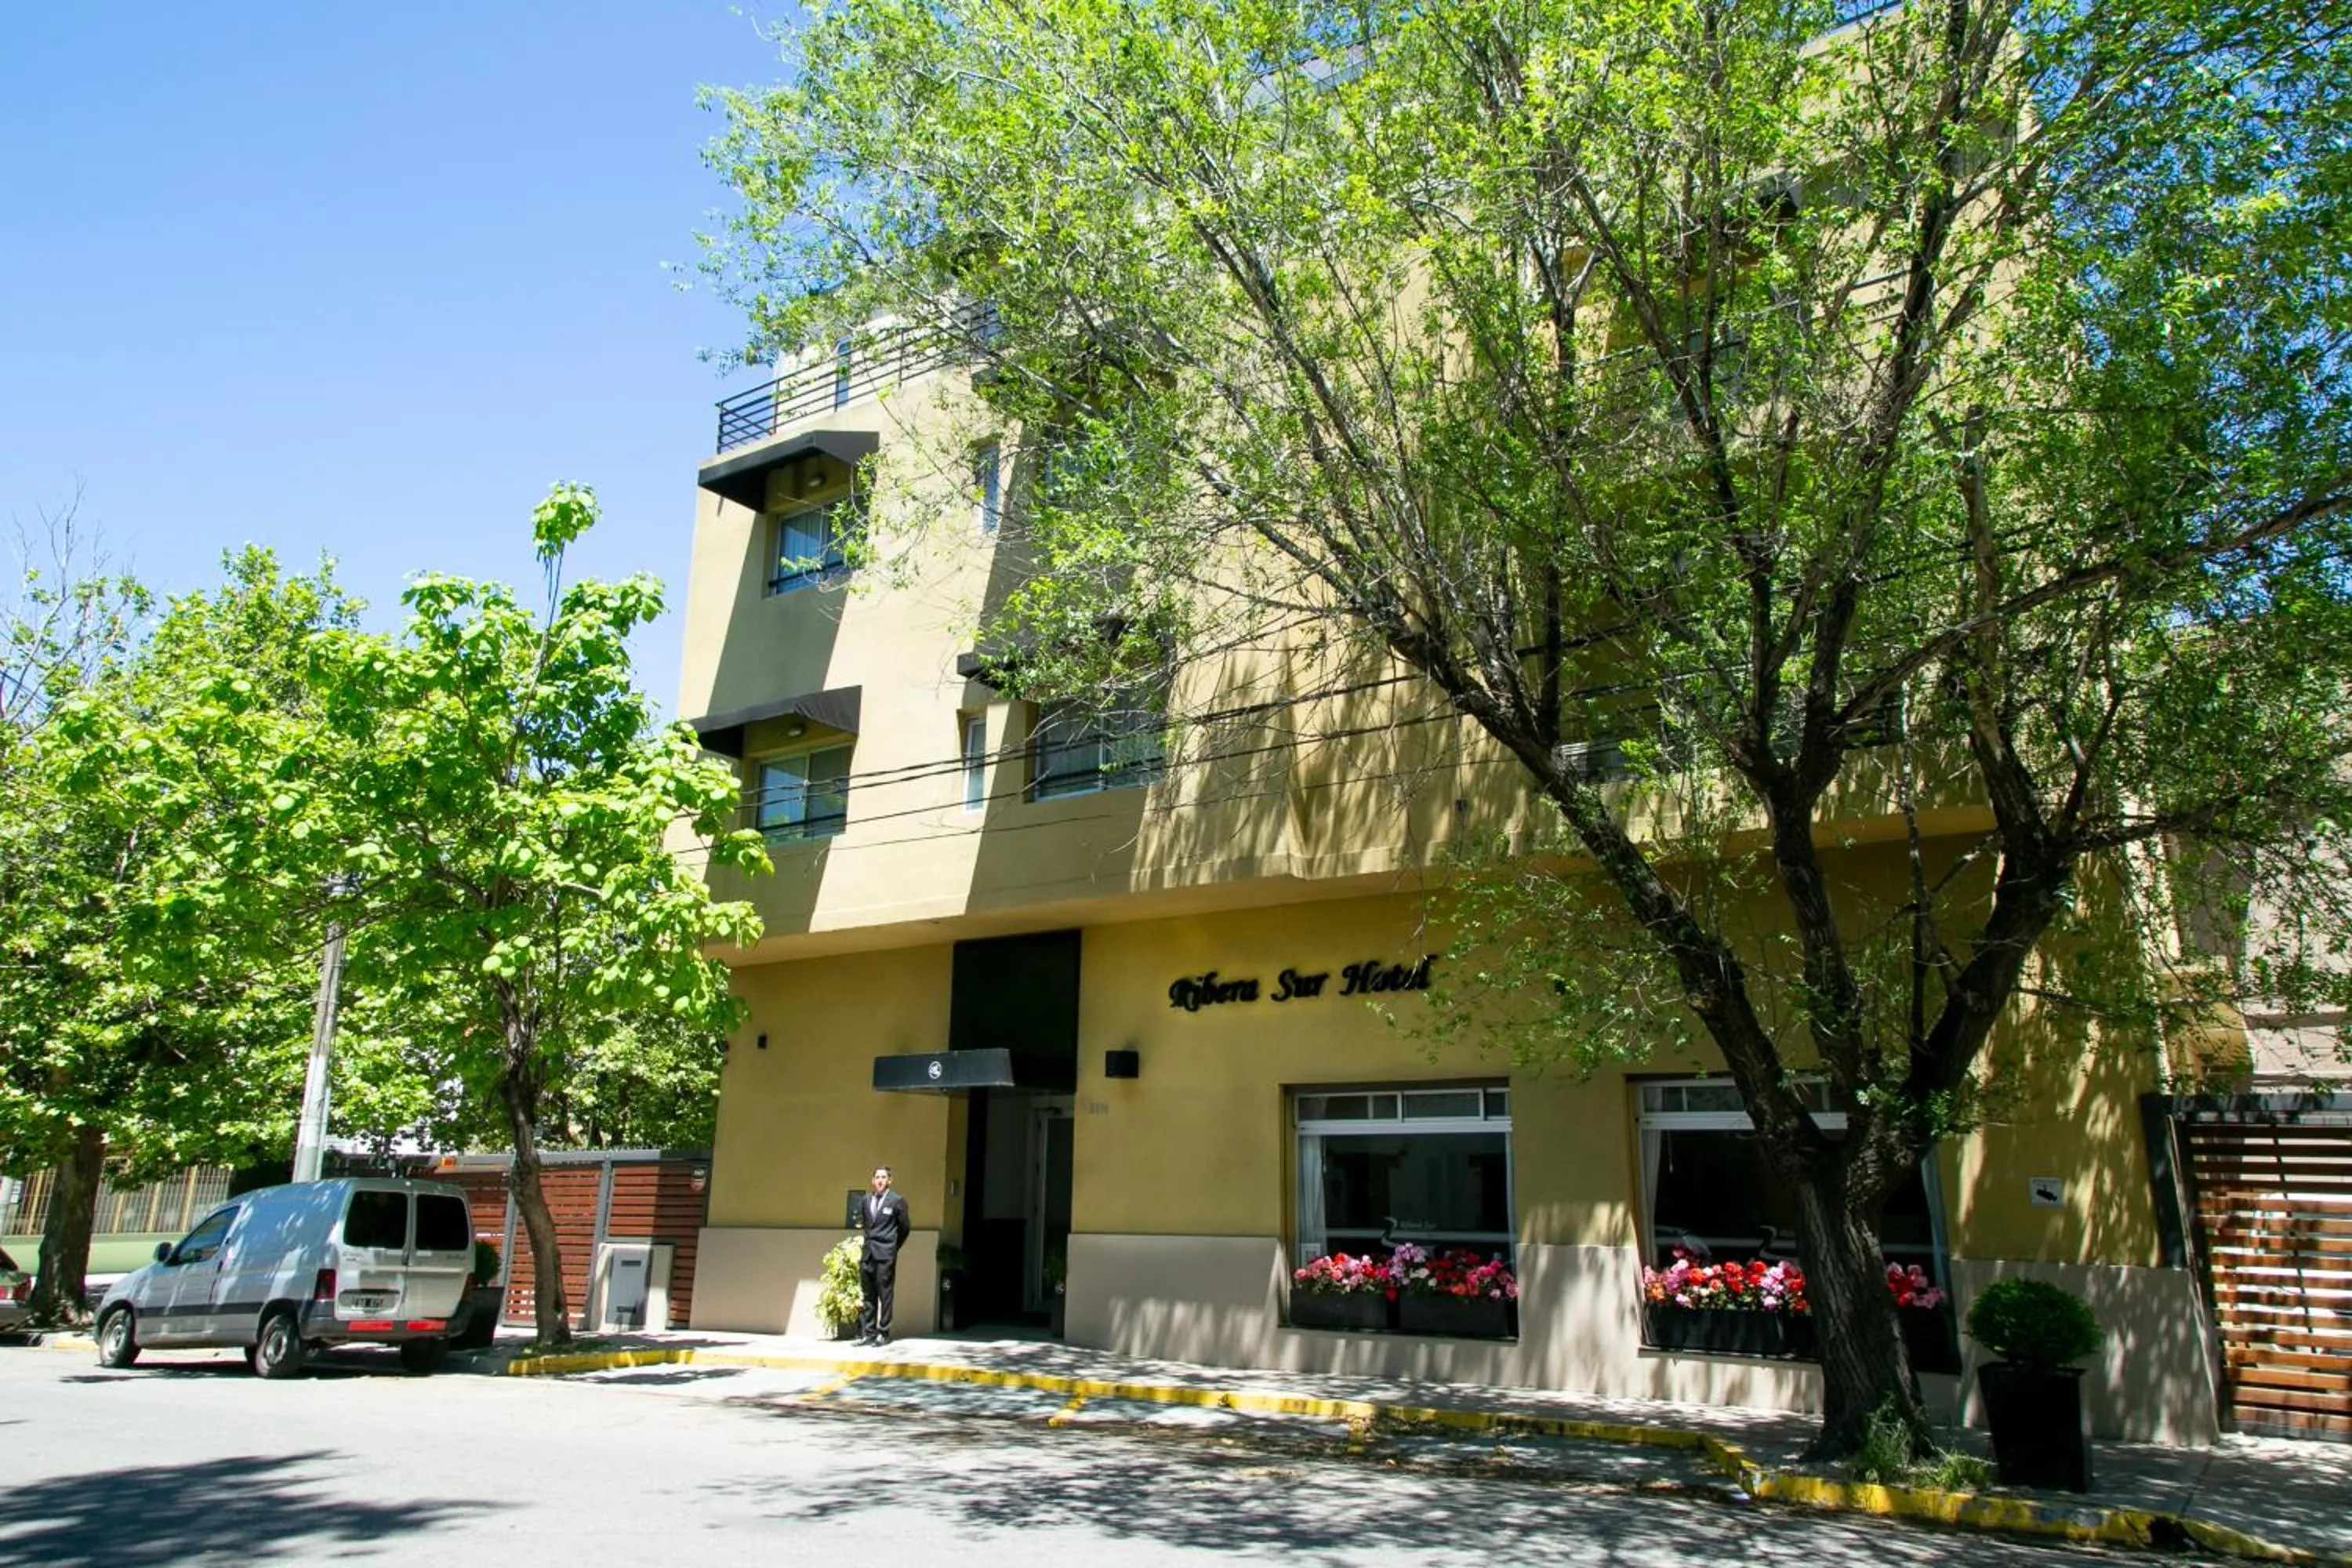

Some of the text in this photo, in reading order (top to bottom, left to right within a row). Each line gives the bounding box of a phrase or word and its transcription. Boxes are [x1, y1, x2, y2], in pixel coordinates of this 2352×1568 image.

[1168, 954, 1438, 1012] Ribera Sur Hotel
